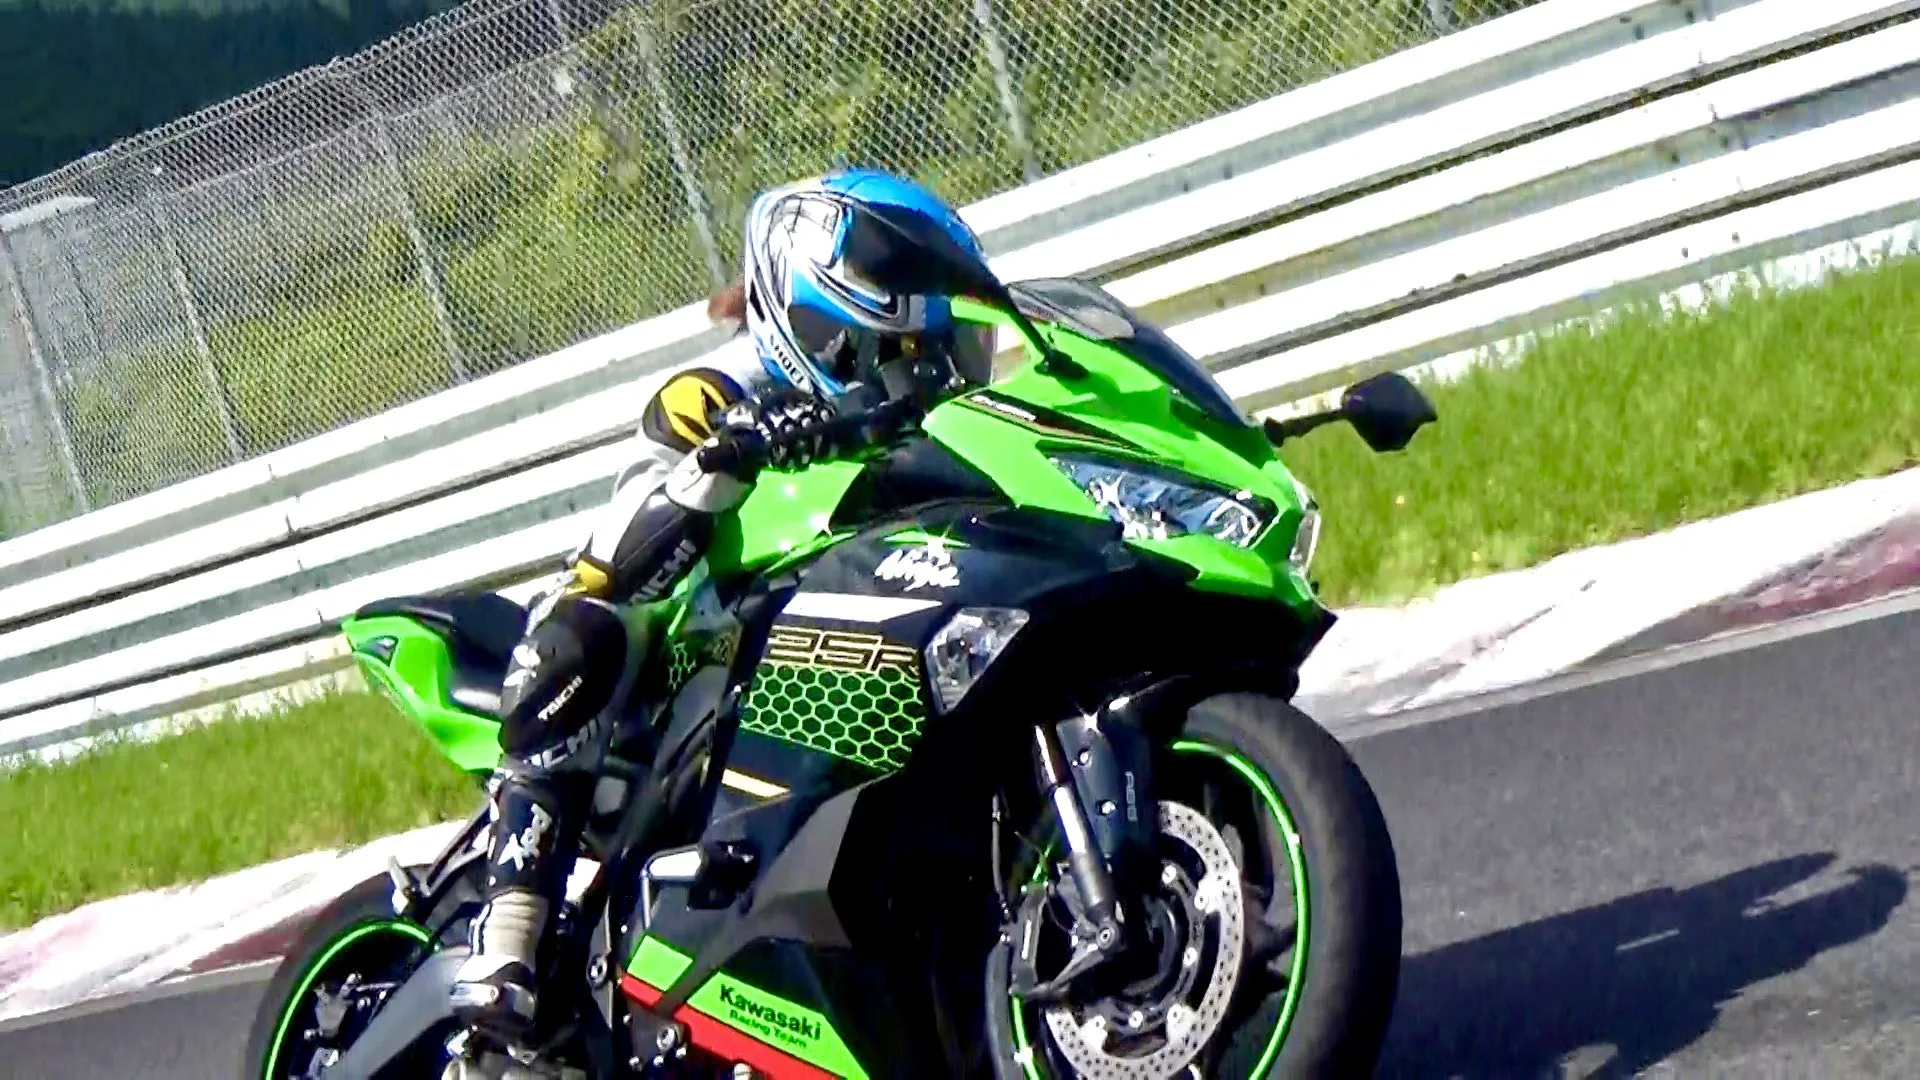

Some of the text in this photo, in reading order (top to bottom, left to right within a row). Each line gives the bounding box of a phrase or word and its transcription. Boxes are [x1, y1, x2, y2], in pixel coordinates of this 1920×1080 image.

[874, 546, 960, 592] Ninja
[720, 983, 822, 1041] Kawasaki
[729, 1009, 771, 1036] Racing
